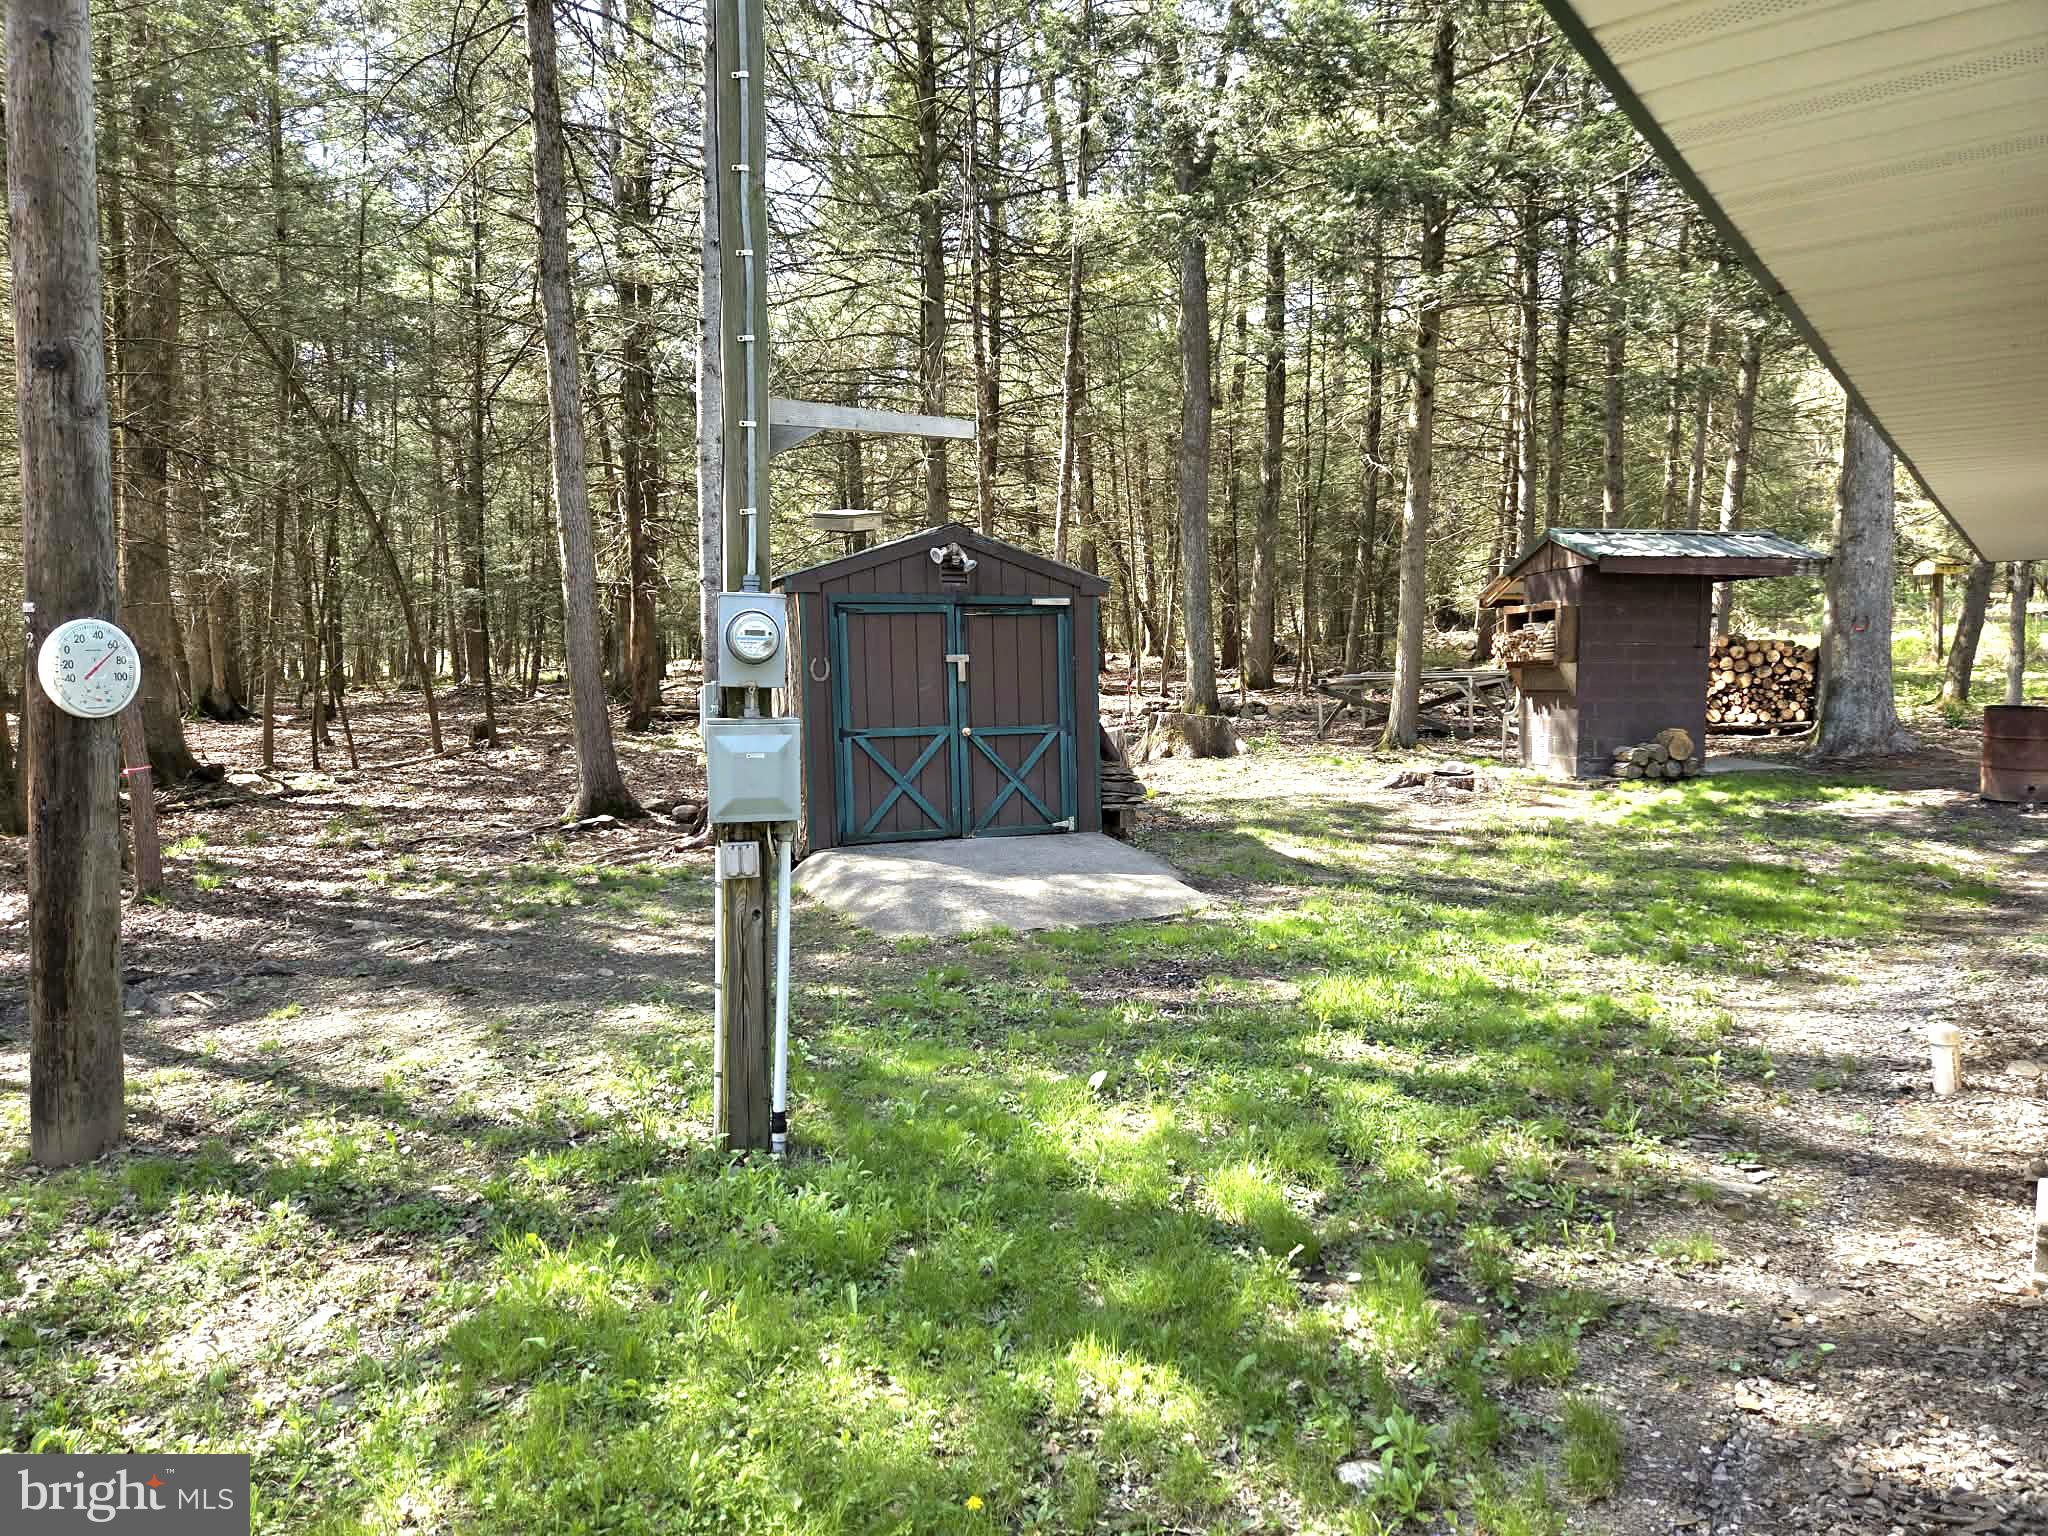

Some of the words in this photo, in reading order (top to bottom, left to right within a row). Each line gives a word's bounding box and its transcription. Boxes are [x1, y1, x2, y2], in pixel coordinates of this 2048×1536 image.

[73, 634, 86, 644] 20
[92, 630, 104, 640] 40
[107, 640, 119, 649] 60
[64, 645, 70, 655] 0
[60, 659, 74, 669] -20
[116, 655, 127, 665] 80
[114, 672, 128, 681] 100
